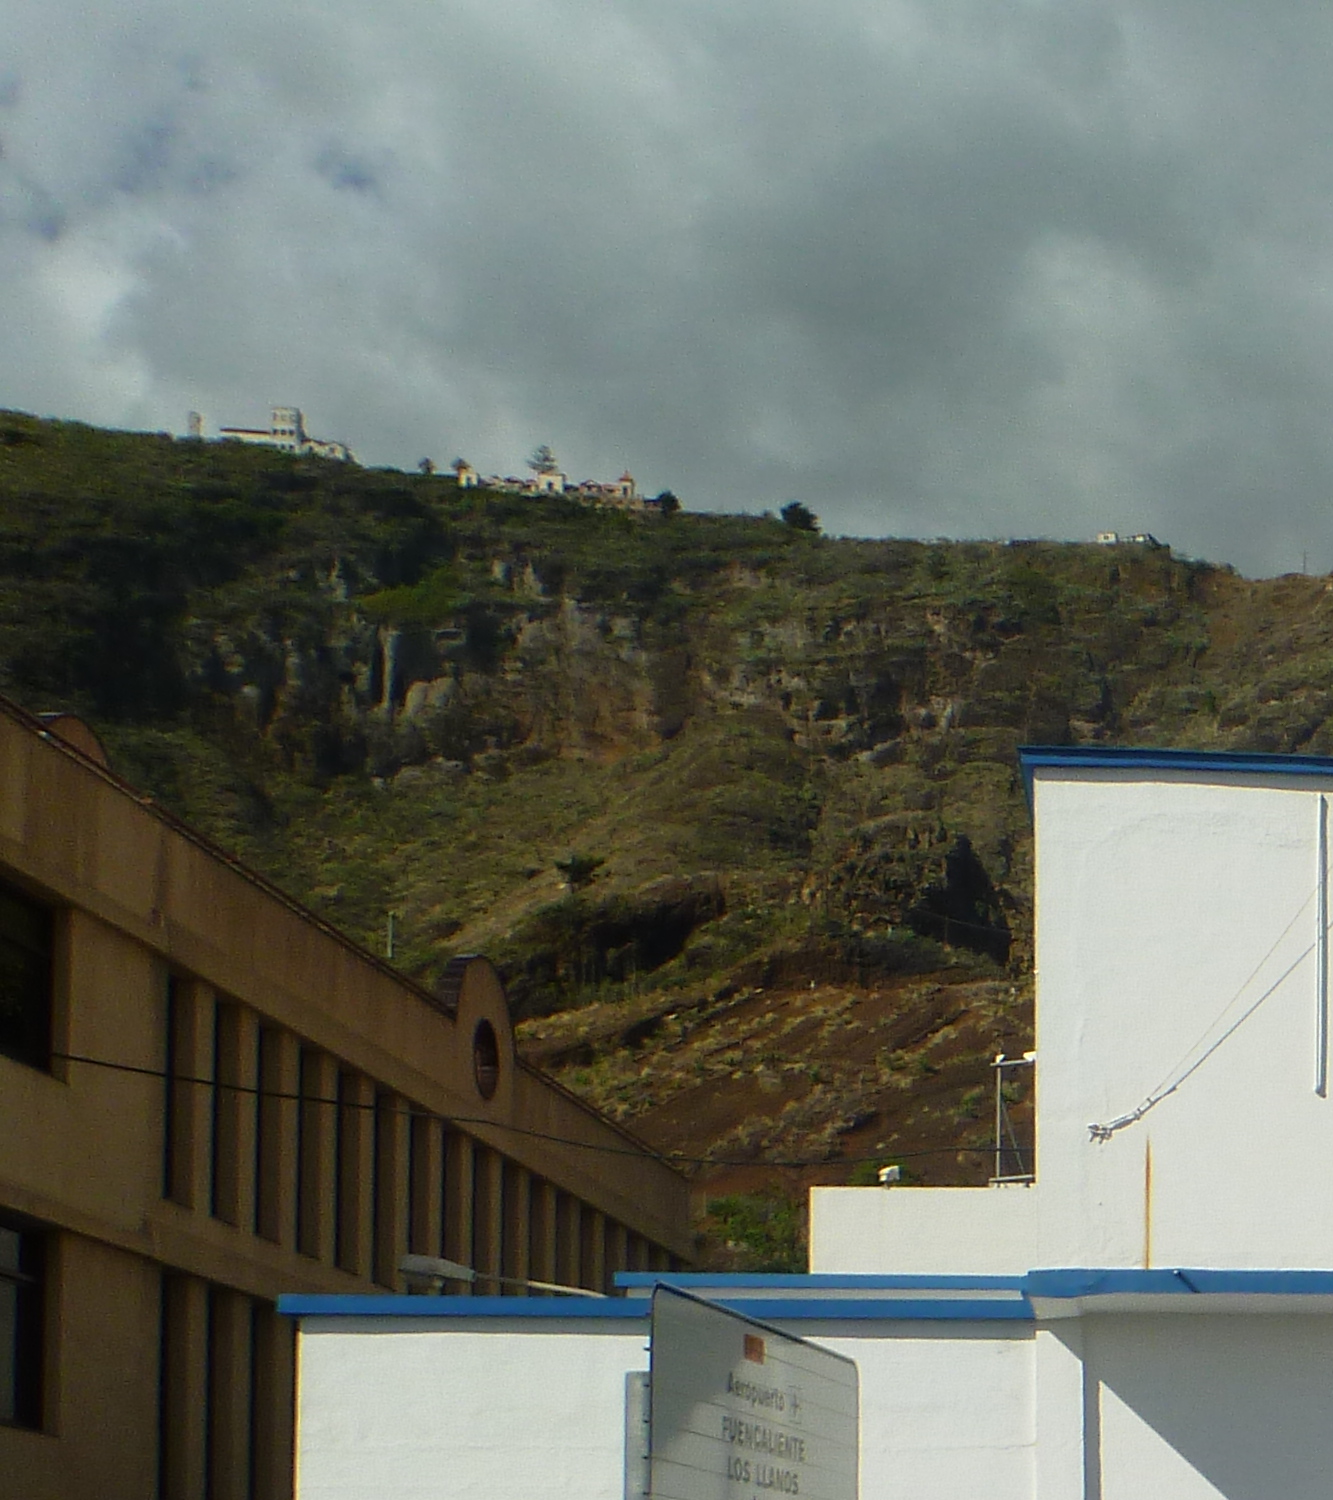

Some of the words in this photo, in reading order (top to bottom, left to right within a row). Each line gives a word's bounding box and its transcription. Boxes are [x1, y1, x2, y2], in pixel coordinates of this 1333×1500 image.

[722, 1415, 806, 1462] FUENCALIENTE
[728, 1456, 751, 1483] LOS
[755, 1464, 799, 1495] LLANOS
